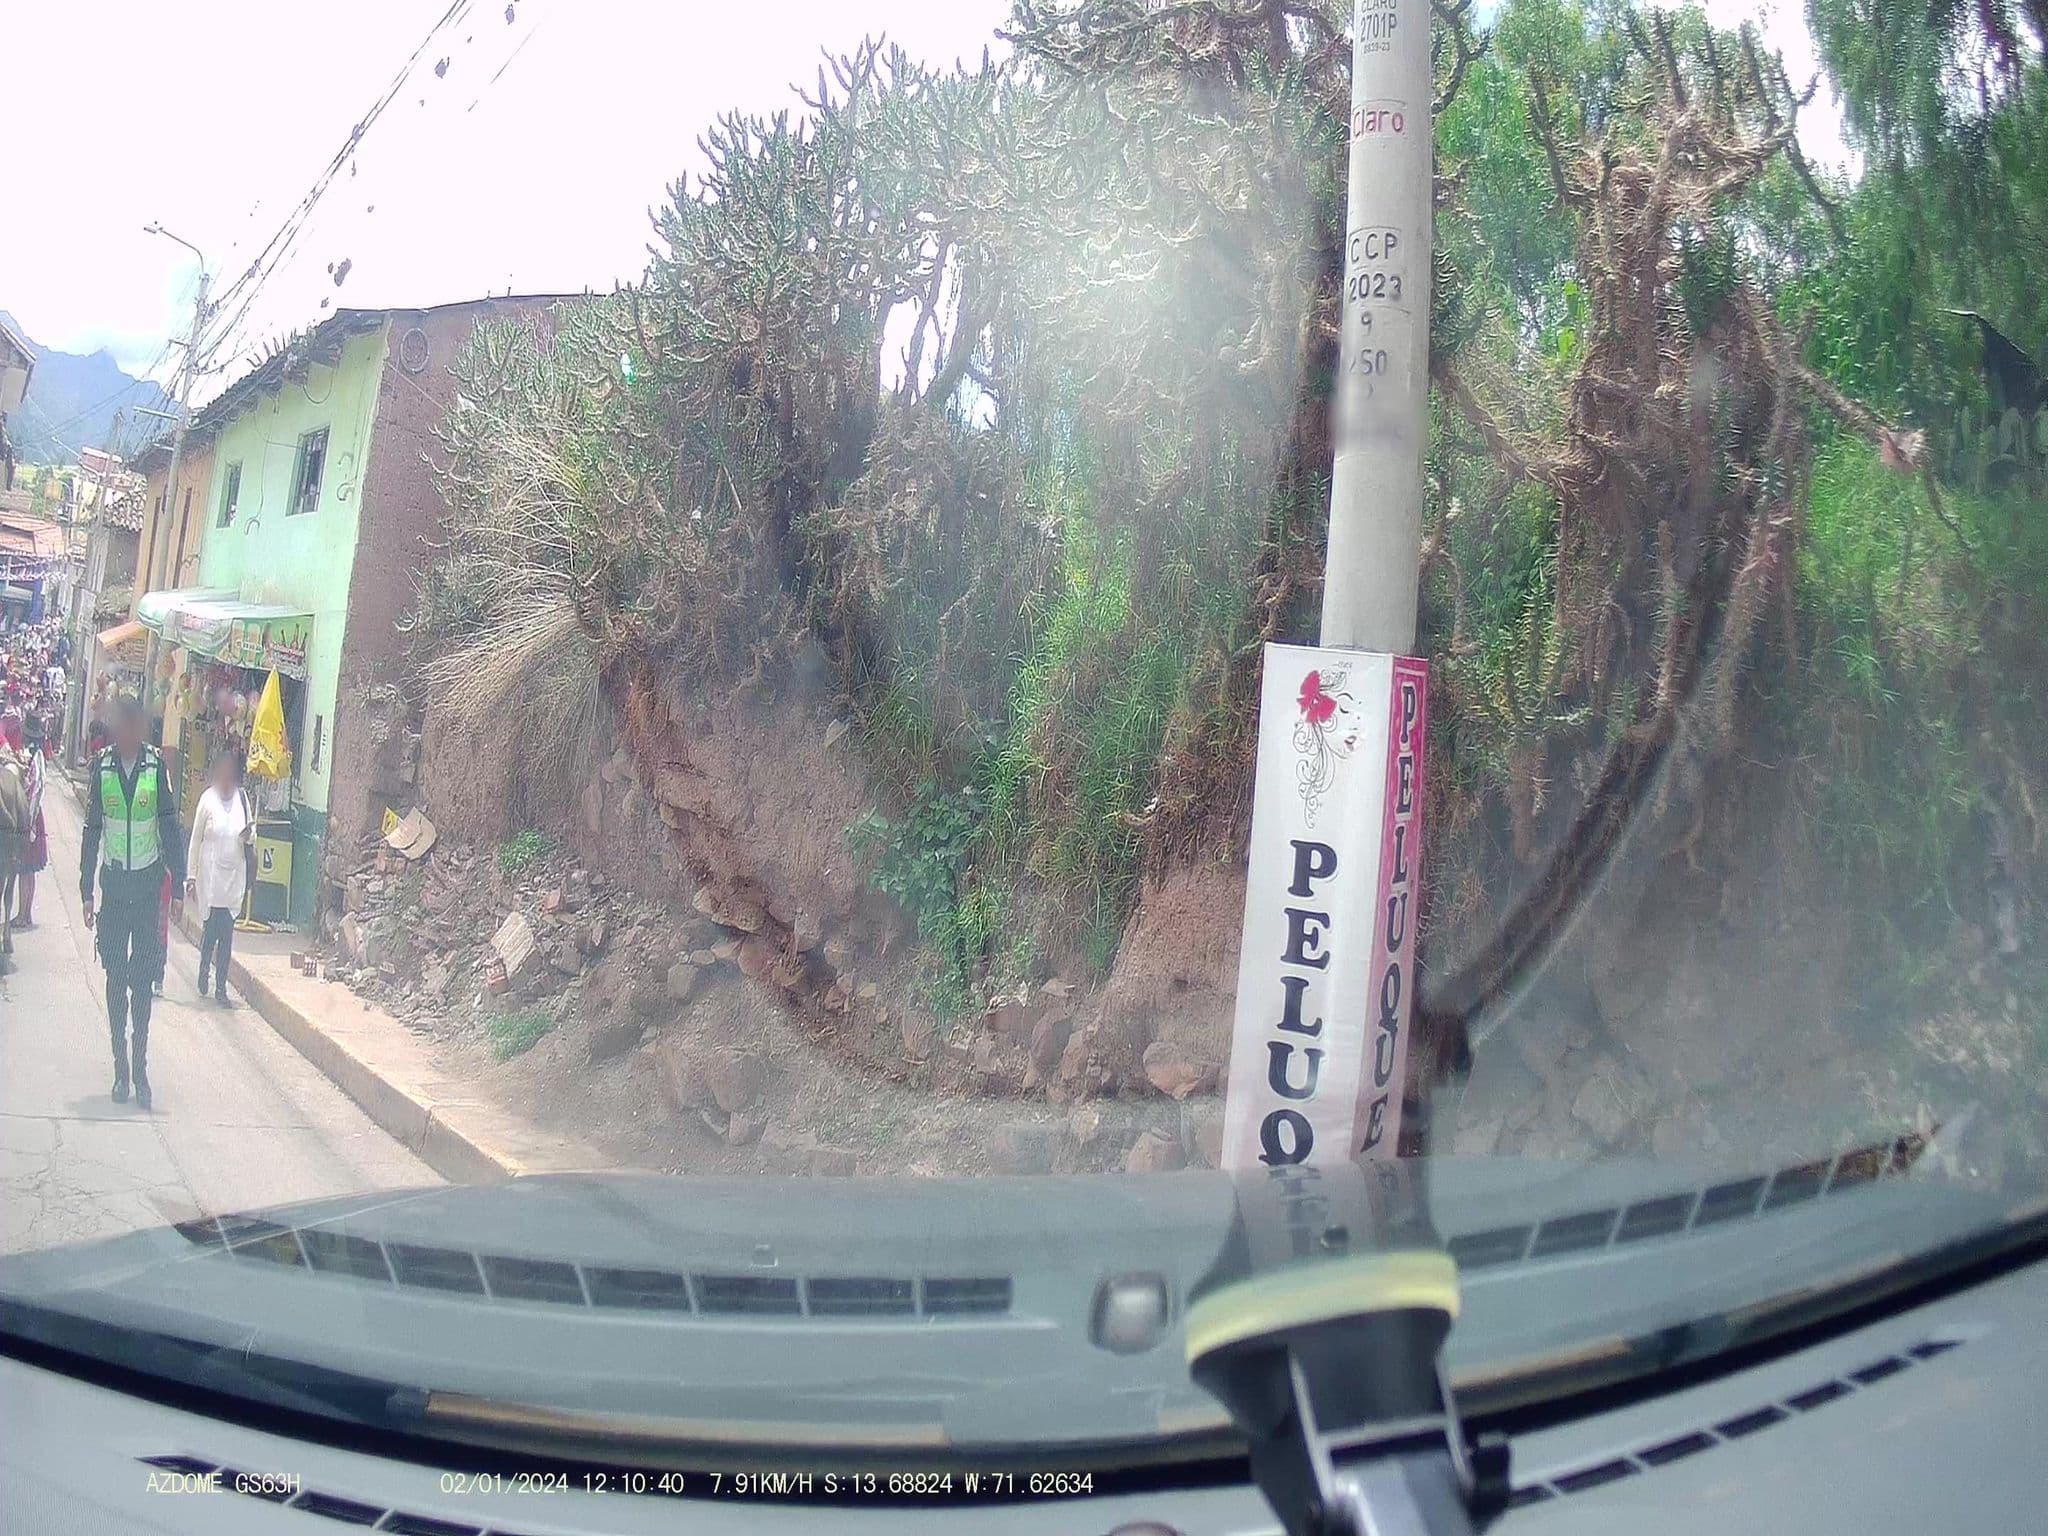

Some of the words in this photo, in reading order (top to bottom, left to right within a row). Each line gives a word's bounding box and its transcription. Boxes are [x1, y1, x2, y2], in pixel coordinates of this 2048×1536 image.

[1360, 12, 1397, 42] 2701P
[1353, 108, 1404, 138] Claro
[1351, 232, 1399, 265] CCP
[1349, 272, 1403, 304] 2023
